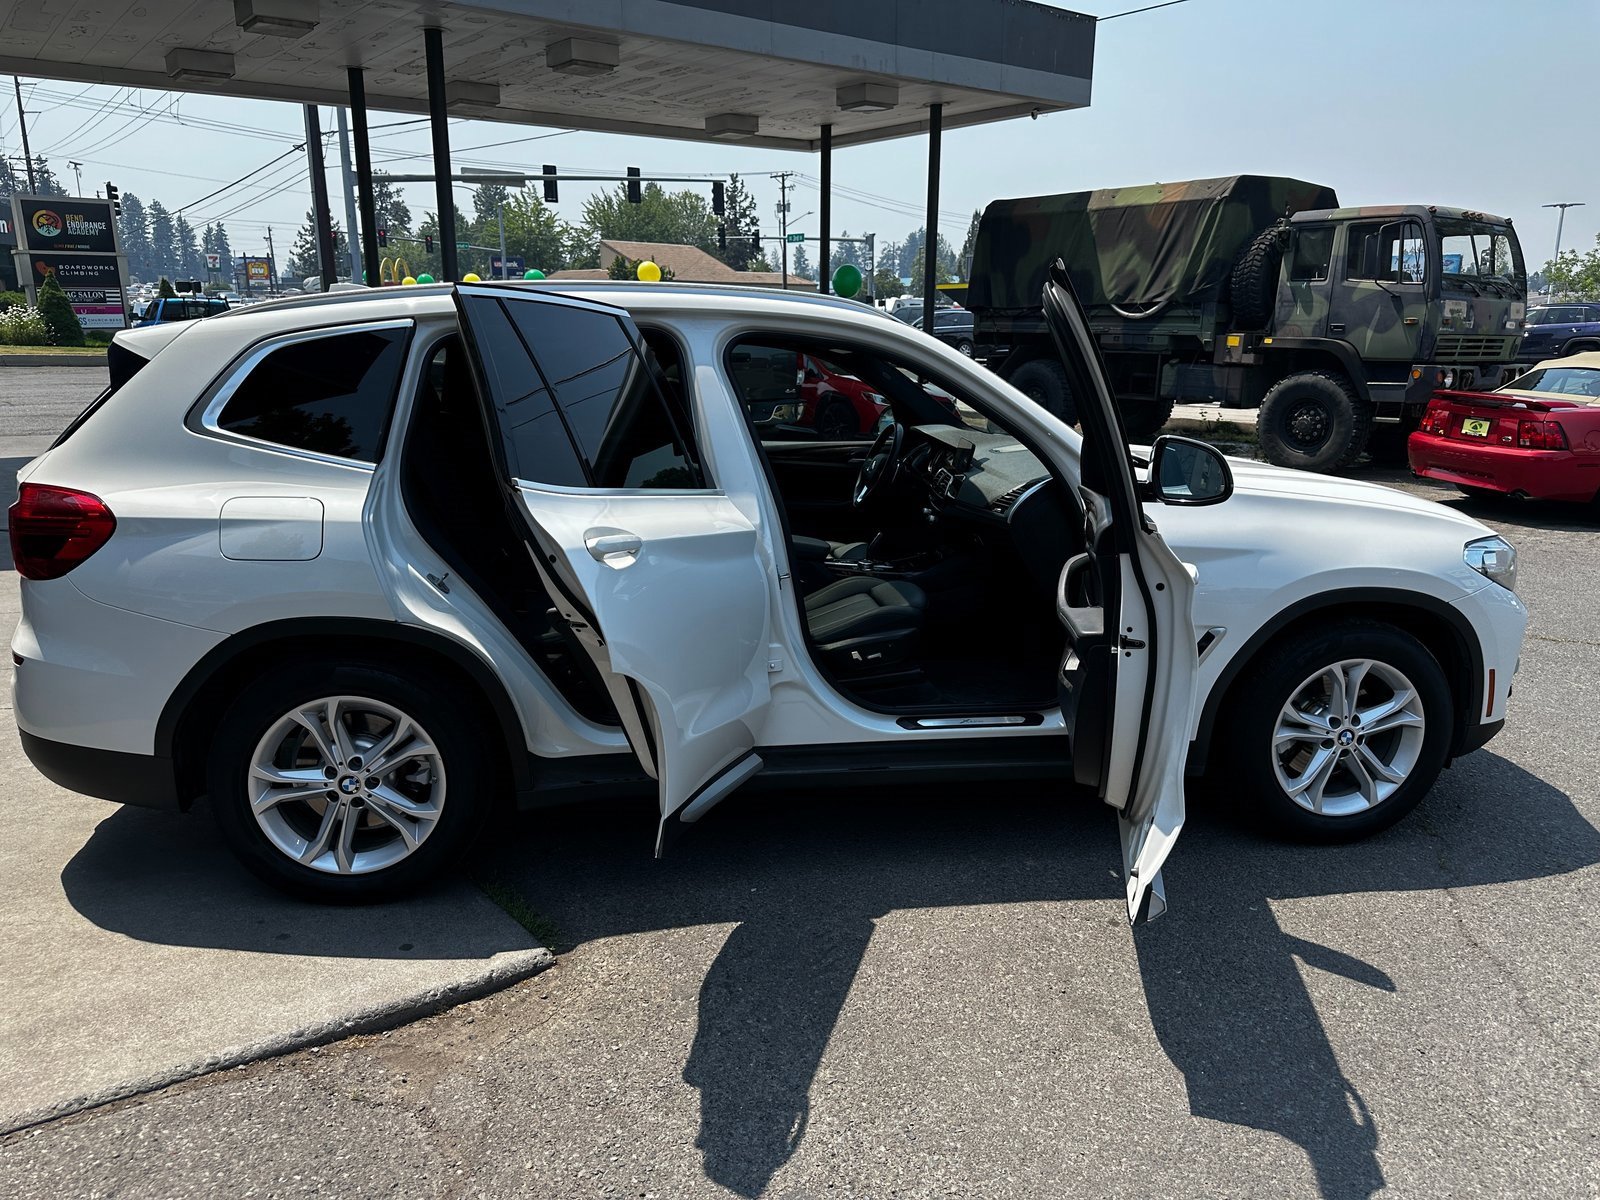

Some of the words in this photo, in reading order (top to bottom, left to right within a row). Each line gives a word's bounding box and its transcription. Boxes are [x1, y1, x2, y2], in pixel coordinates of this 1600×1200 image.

[65, 214, 84, 222] BEND
[66, 220, 107, 230] ENDURANCE
[67, 228, 99, 236] ACADEMY
[78, 291, 104, 299] SALON
